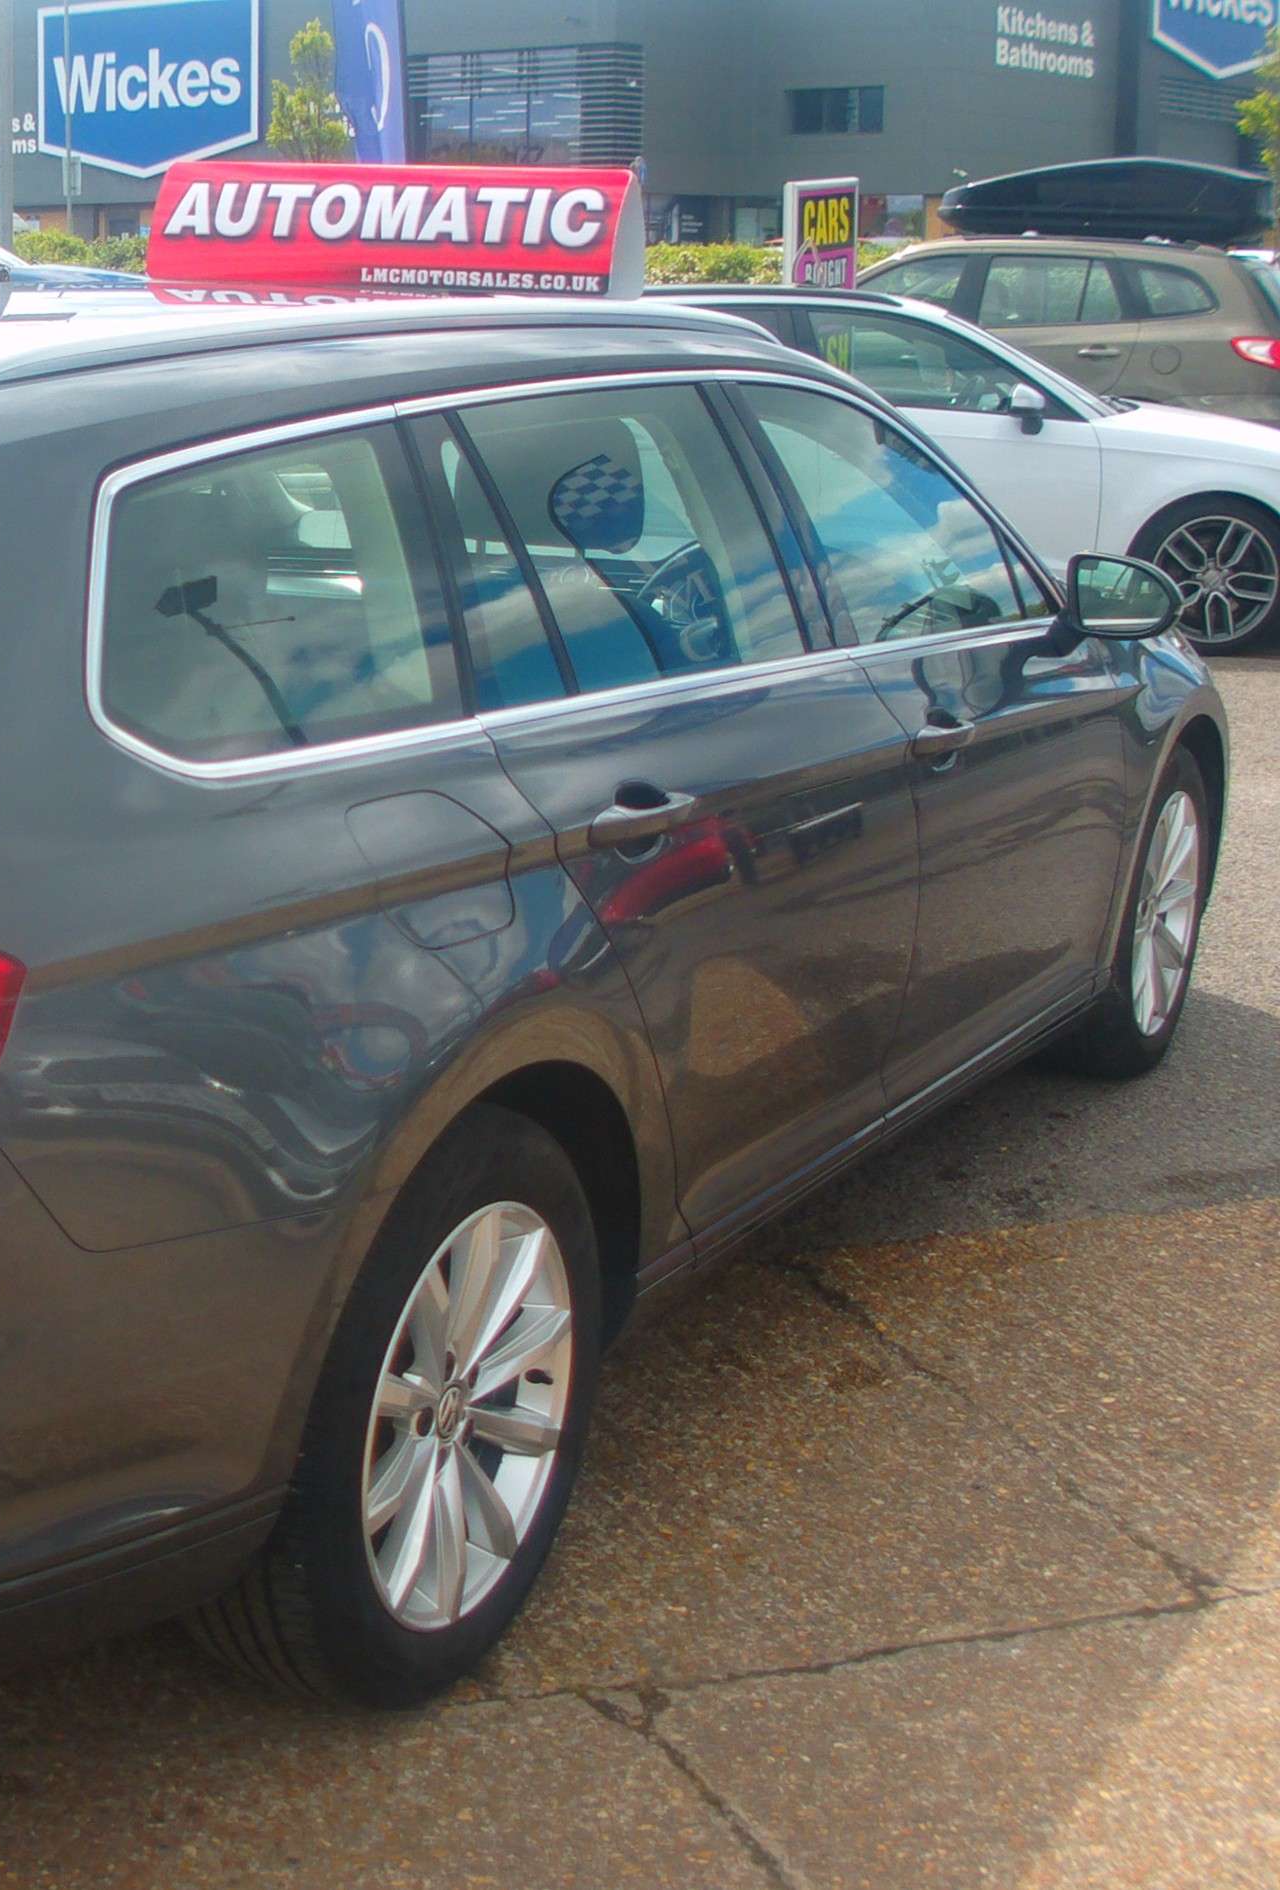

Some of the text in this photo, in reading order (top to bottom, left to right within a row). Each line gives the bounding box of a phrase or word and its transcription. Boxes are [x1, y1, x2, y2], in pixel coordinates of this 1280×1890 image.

[997, 6, 1095, 47] Kitchens &
[996, 37, 1094, 78] Bathrooms
[53, 48, 242, 115] Wickes
[23, 113, 36, 132] &
[163, 182, 605, 247] AUTOMATIC
[803, 197, 850, 246] CARS
[360, 267, 601, 292] LMCMOTORSALES.CO.UK
